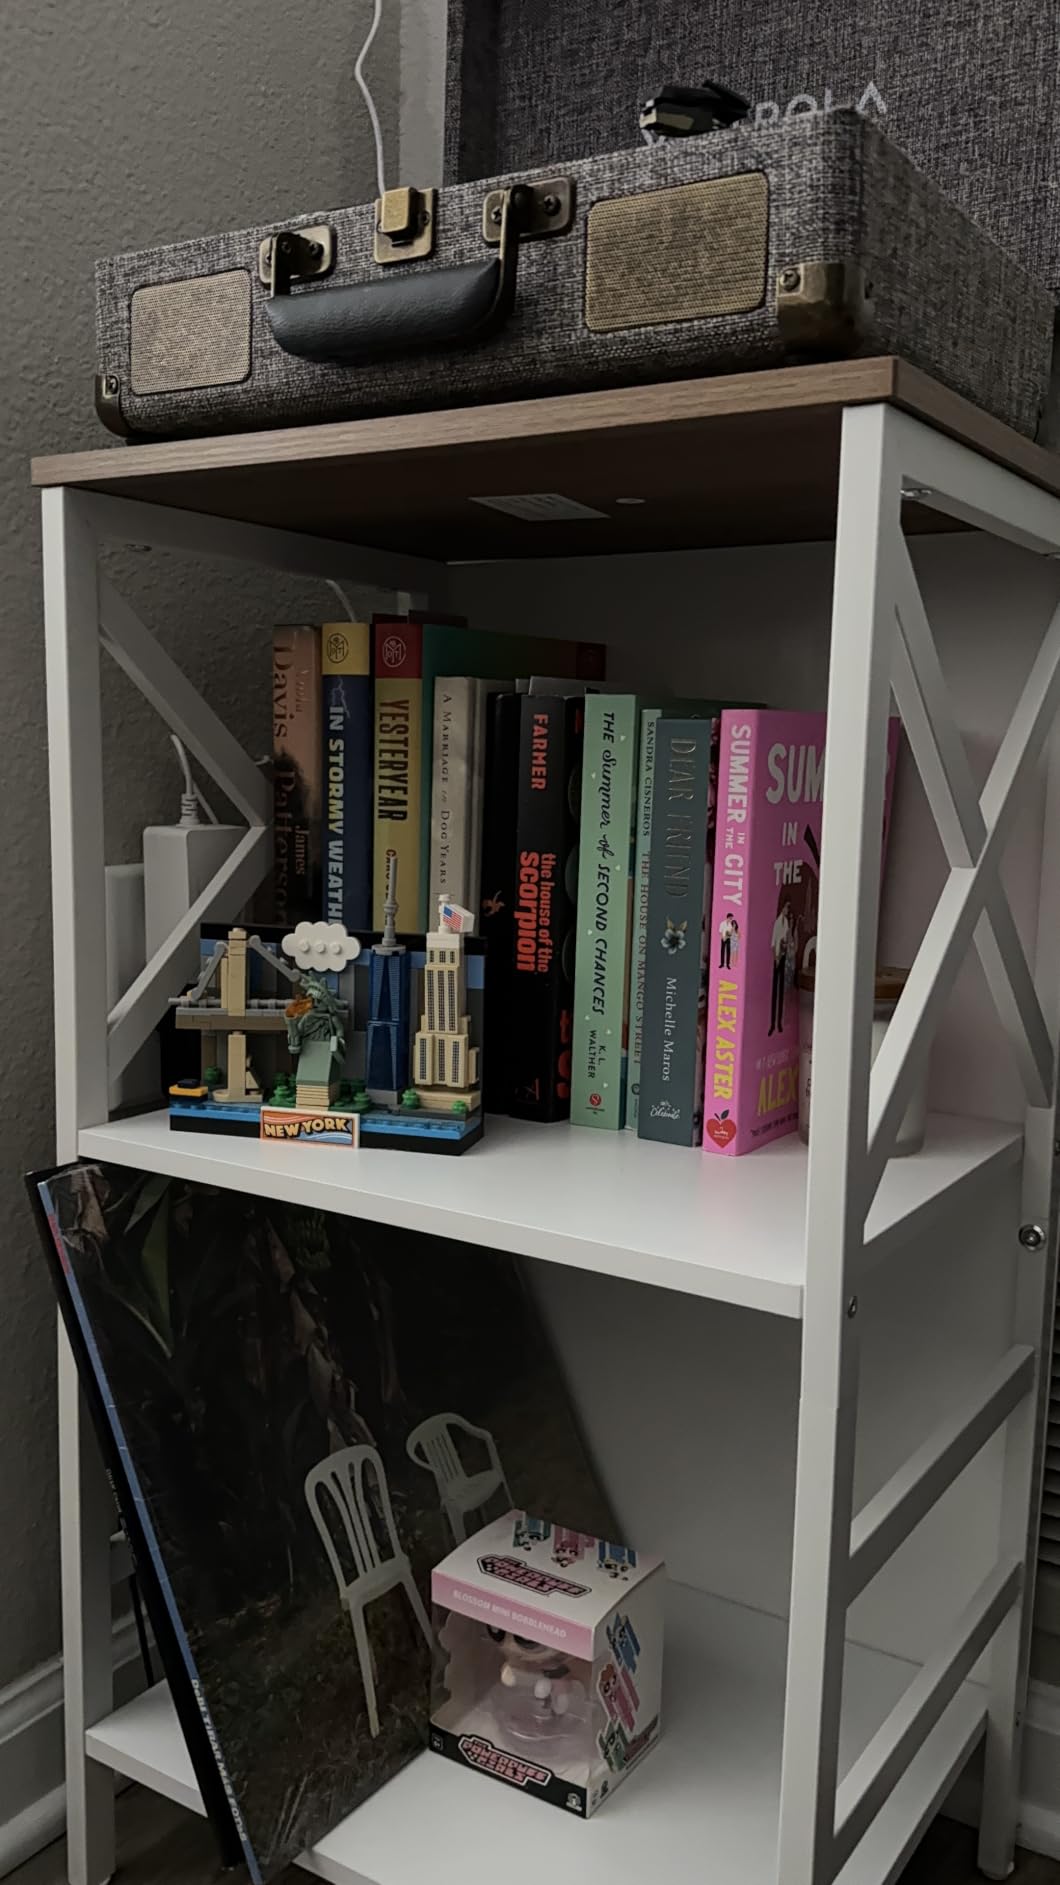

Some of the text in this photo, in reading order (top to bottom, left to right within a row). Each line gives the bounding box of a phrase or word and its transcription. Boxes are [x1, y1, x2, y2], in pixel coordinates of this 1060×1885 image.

[273, 647, 294, 738] Davis
[442, 694, 452, 703] A
[328, 706, 345, 731] IN
[377, 699, 409, 821] YESTERYEAR
[441, 711, 452, 783] MARRIAGE
[531, 713, 549, 790] FARMER
[328, 738, 345, 834] STORMY
[643, 721, 655, 837] SANDRA CISNEROS
[726, 724, 751, 824] SUMMER
[440, 811, 450, 840] DOG
[663, 737, 697, 898] DEAR FRIEND
[725, 828, 734, 849] THE
[736, 832, 747, 844] IN
[781, 821, 798, 847] IN
[295, 825, 310, 875] James
[439, 843, 450, 884] YEARS
[592, 712, 617, 1015] THE Summer of SECOND CHANCES
[641, 852, 650, 883] THE
[773, 859, 803, 886] THE
[722, 853, 745, 907] CITY
[536, 852, 557, 973] the house of the
[639, 886, 649, 928] HOUSE
[638, 935, 647, 956] ON
[636, 960, 646, 1010] MANGO
[716, 979, 738, 1033] ALEX
[587, 1029, 597, 1079] WALTHER
[661, 976, 678, 1083] Michelle Maros
[713, 1036, 736, 1100] ASTER
[263, 1117, 350, 1138] NEW YORK
[512, 1610, 567, 1638] BOBBLEHEAD
